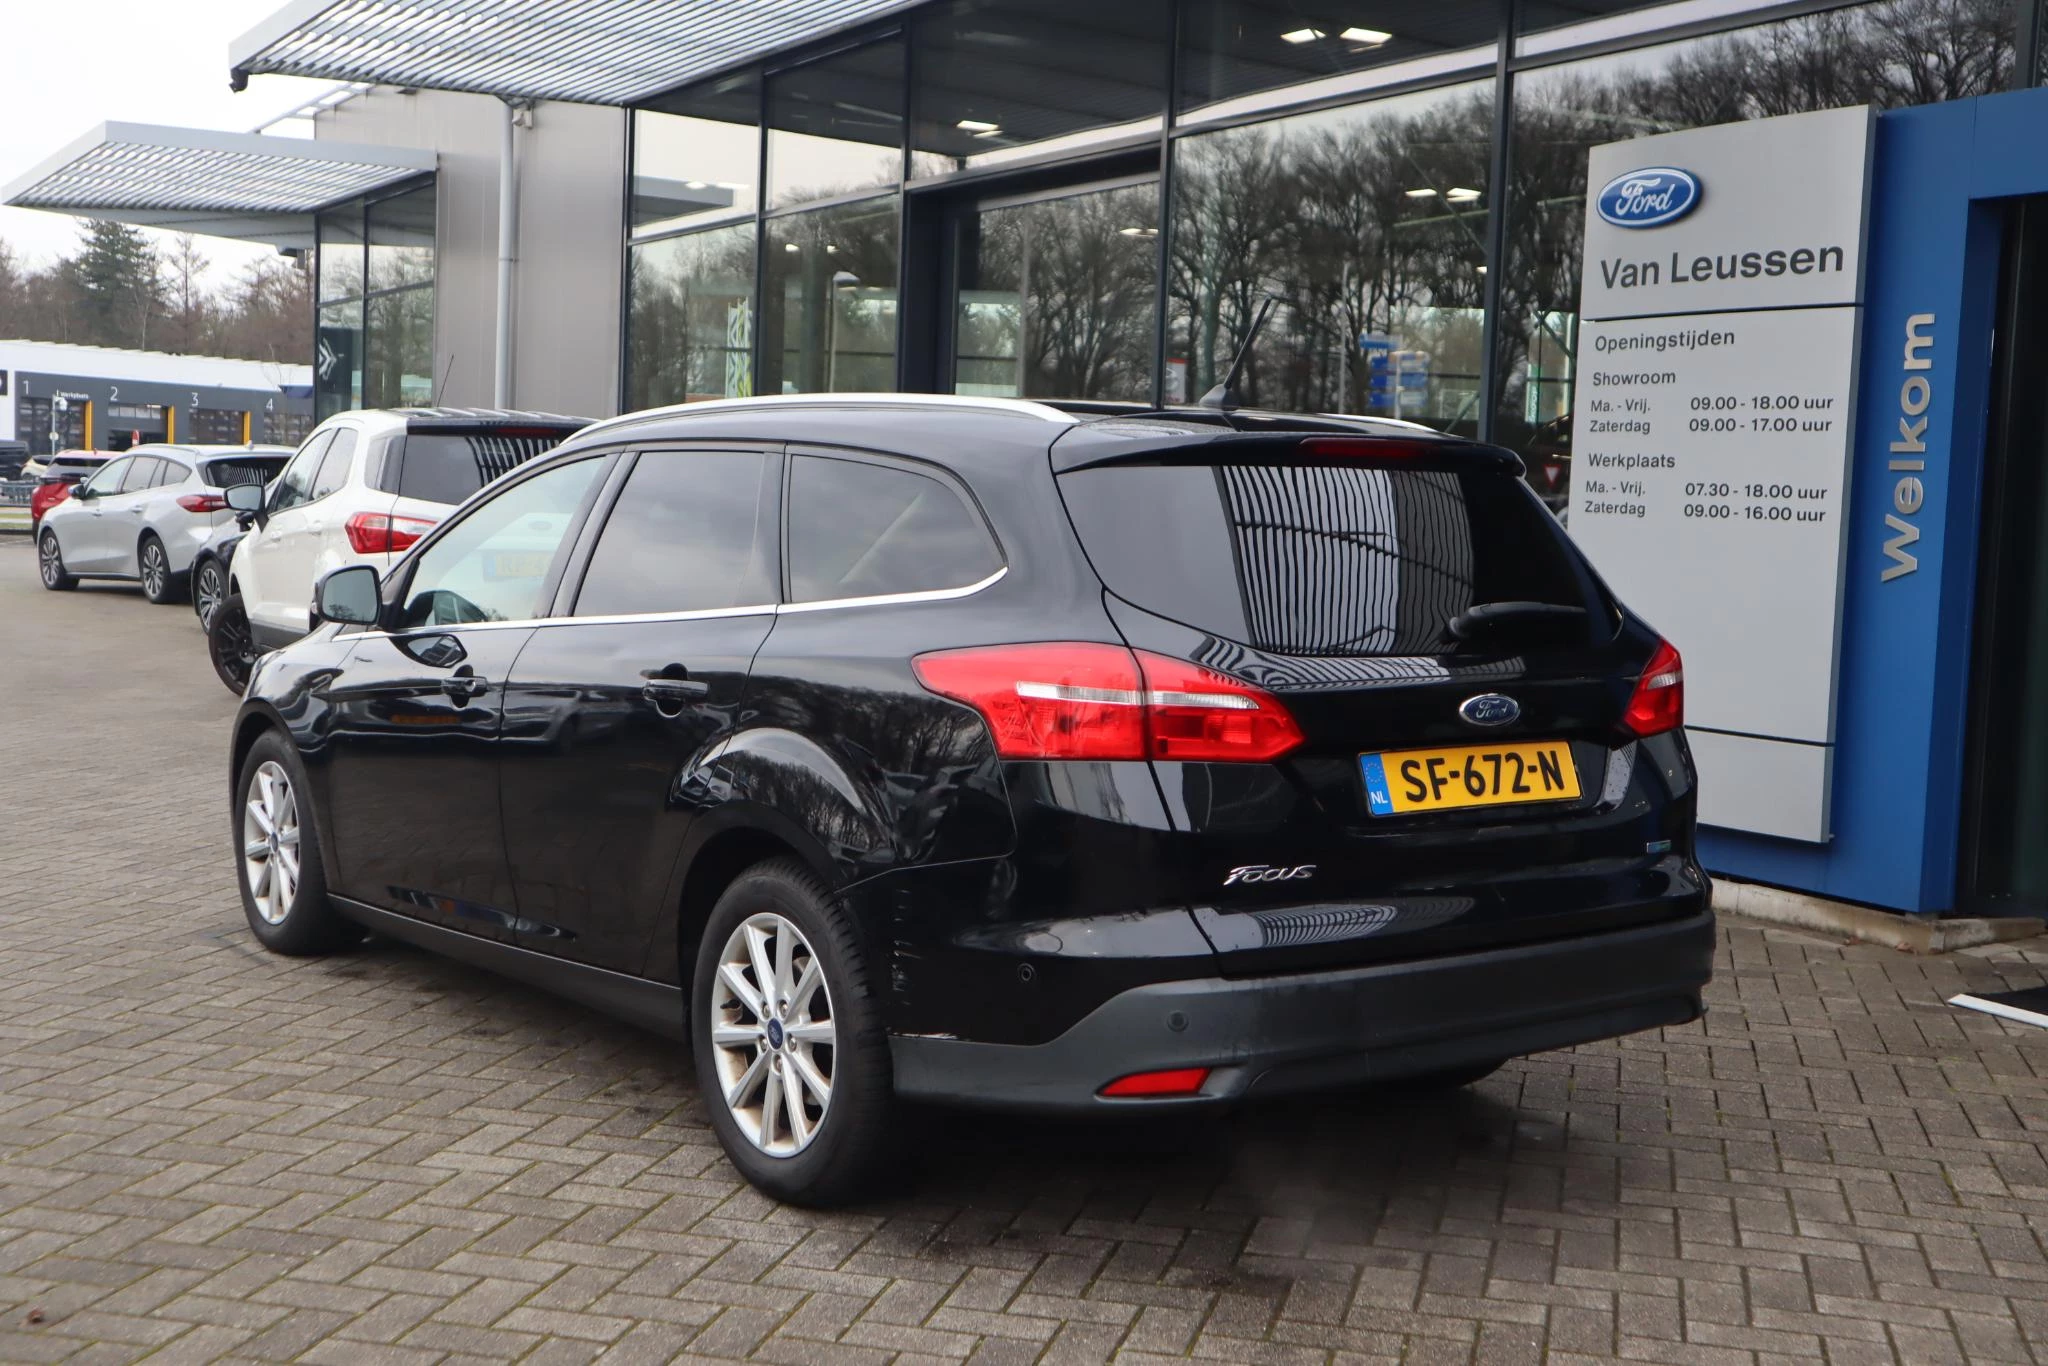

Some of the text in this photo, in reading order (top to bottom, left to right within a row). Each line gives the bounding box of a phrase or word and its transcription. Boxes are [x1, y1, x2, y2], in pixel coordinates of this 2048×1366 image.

[1615, 177, 1676, 216] Ford
[1600, 244, 1844, 289] Van Leussen
[1595, 329, 1735, 354] Openingstijden
[23, 380, 29, 395] 1
[1593, 371, 1676, 386] Showroom
[110, 386, 118, 401] 2
[191, 392, 199, 407] 3
[265, 398, 274, 412] 4
[1591, 400, 1614, 412] Ma.
[1625, 398, 1651, 414] Vrij.
[1690, 396, 1737, 410] 09.00
[1751, 395, 1800, 410] 18.00
[1804, 398, 1834, 409] uur
[1589, 419, 1651, 435] Zaterdag
[1689, 418, 1736, 431] 09.00
[1751, 418, 1798, 431] 17.00
[1802, 420, 1832, 431] uur
[1880, 313, 1935, 583] Welkom
[1588, 453, 1676, 471] Werkplaats
[1585, 480, 1609, 493] Ma.
[1620, 481, 1646, 496] Vrij.
[1685, 482, 1730, 496] 07.30
[1745, 484, 1793, 498] 18.00
[1798, 488, 1828, 499] uur
[1585, 500, 1646, 518] Zaterdag
[1684, 504, 1730, 518] 09.00
[1745, 506, 1792, 521] 16.00
[1797, 511, 1826, 522] uur
[1475, 699, 1509, 719] Ford
[1400, 750, 1565, 803] SF-672-N
[1370, 791, 1388, 804] NL
